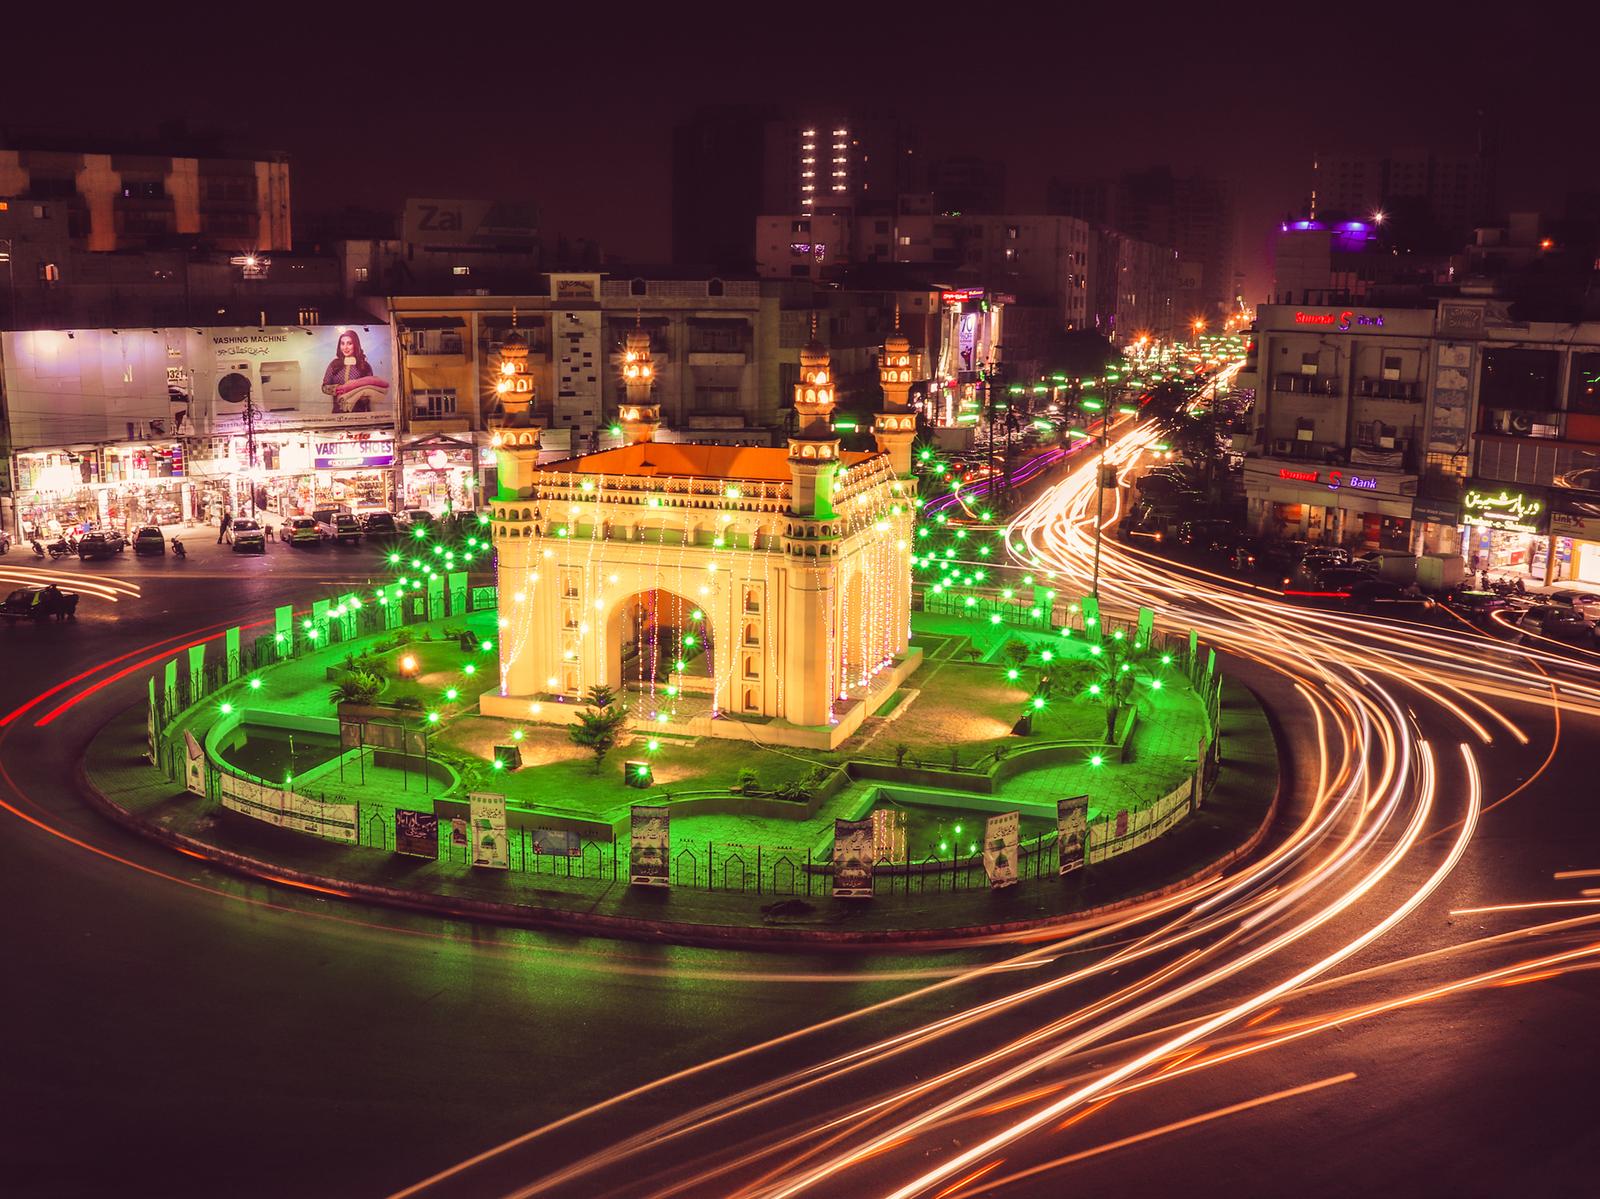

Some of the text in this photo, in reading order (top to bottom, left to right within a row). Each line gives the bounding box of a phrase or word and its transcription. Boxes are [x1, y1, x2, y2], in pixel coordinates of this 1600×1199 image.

[251, 335, 288, 343] MACHINE
[359, 441, 392, 453] SHOES
[1350, 476, 1378, 490] Bank
